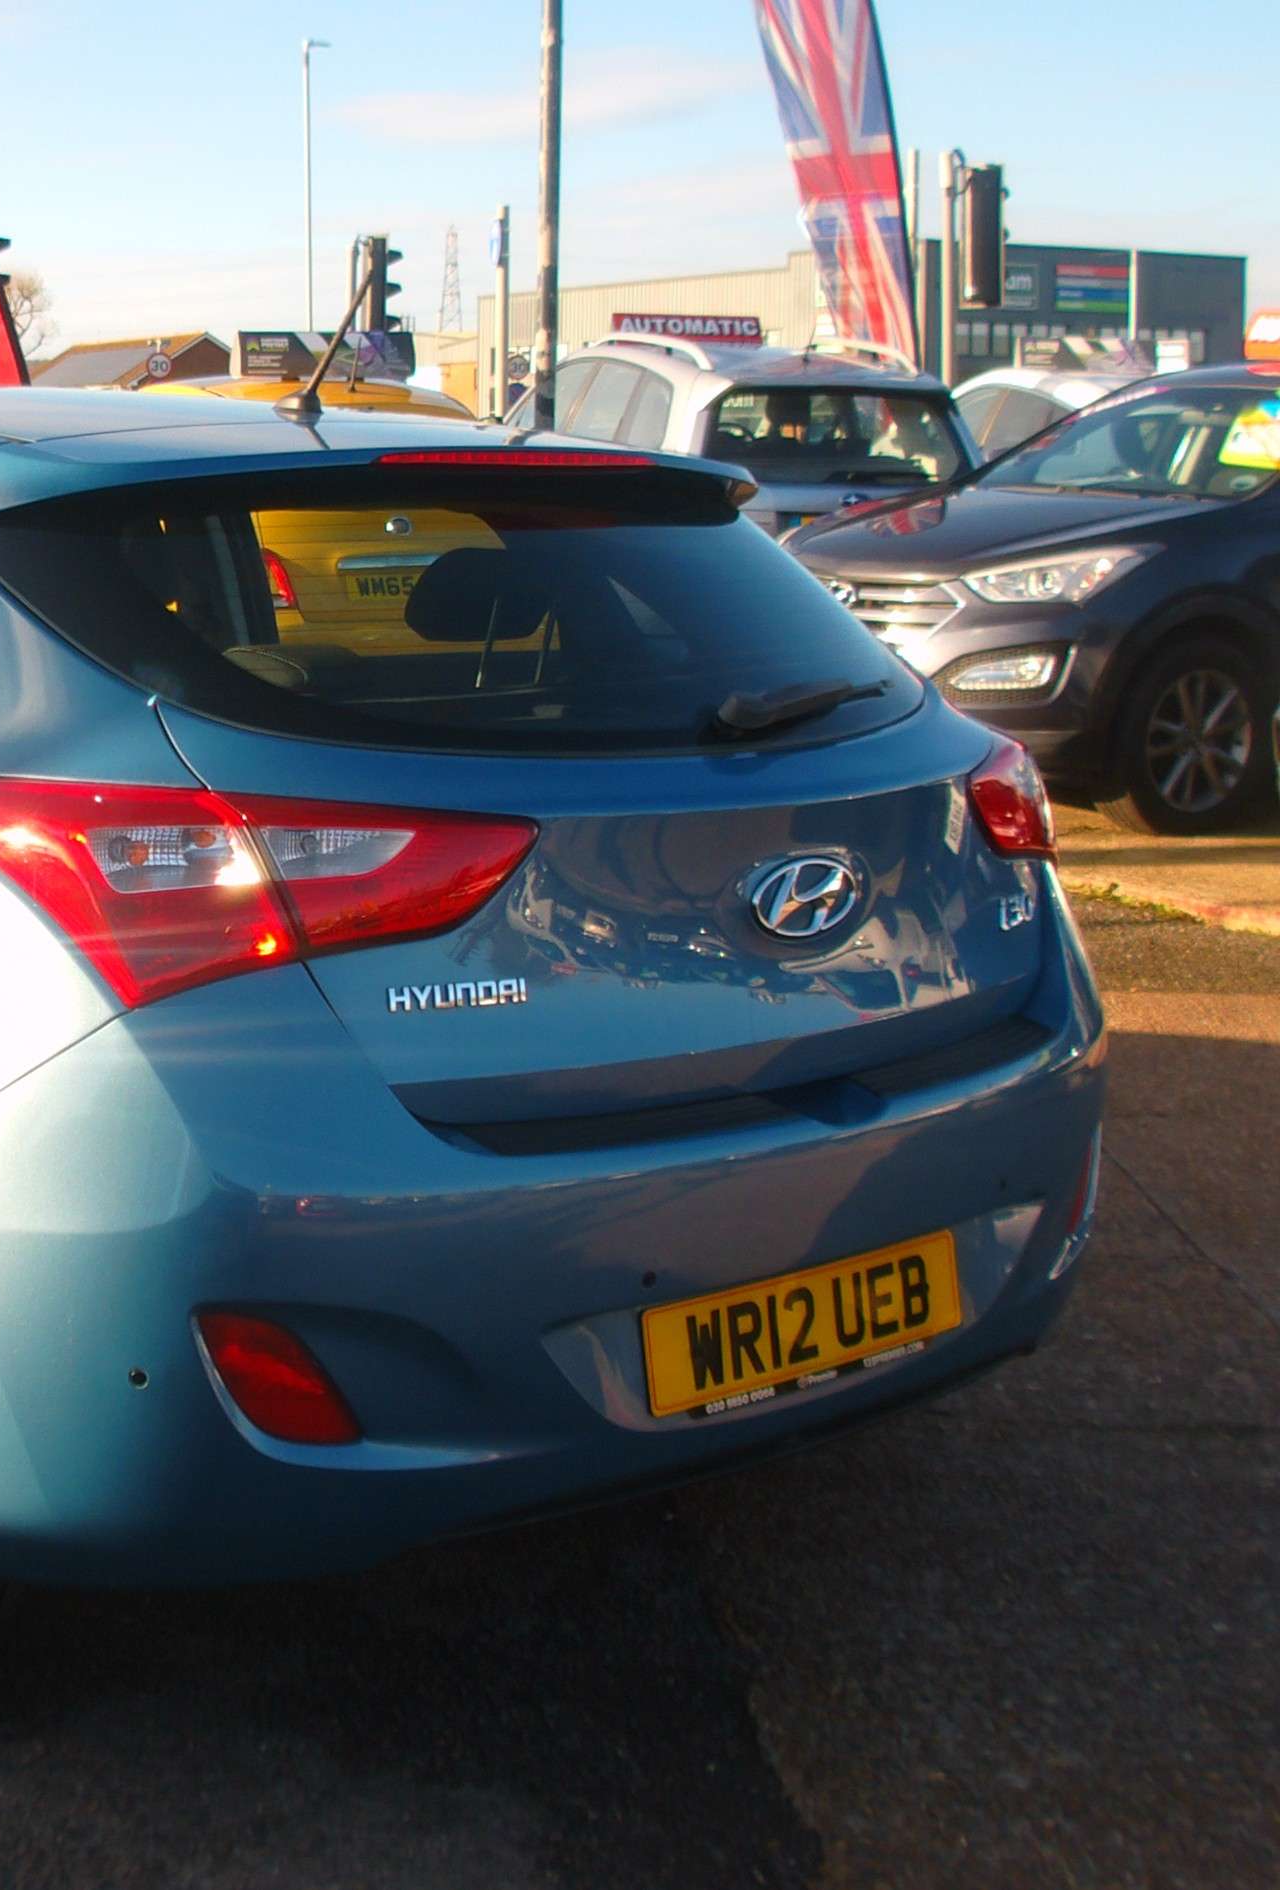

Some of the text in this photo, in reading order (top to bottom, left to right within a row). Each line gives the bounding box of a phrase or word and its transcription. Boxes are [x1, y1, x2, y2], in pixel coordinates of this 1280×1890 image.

[620, 317, 759, 336] AUTOMATIC
[151, 360, 169, 372] 30
[387, 977, 528, 1013] HYUNDAI
[685, 1254, 932, 1392] WR12 UEB
